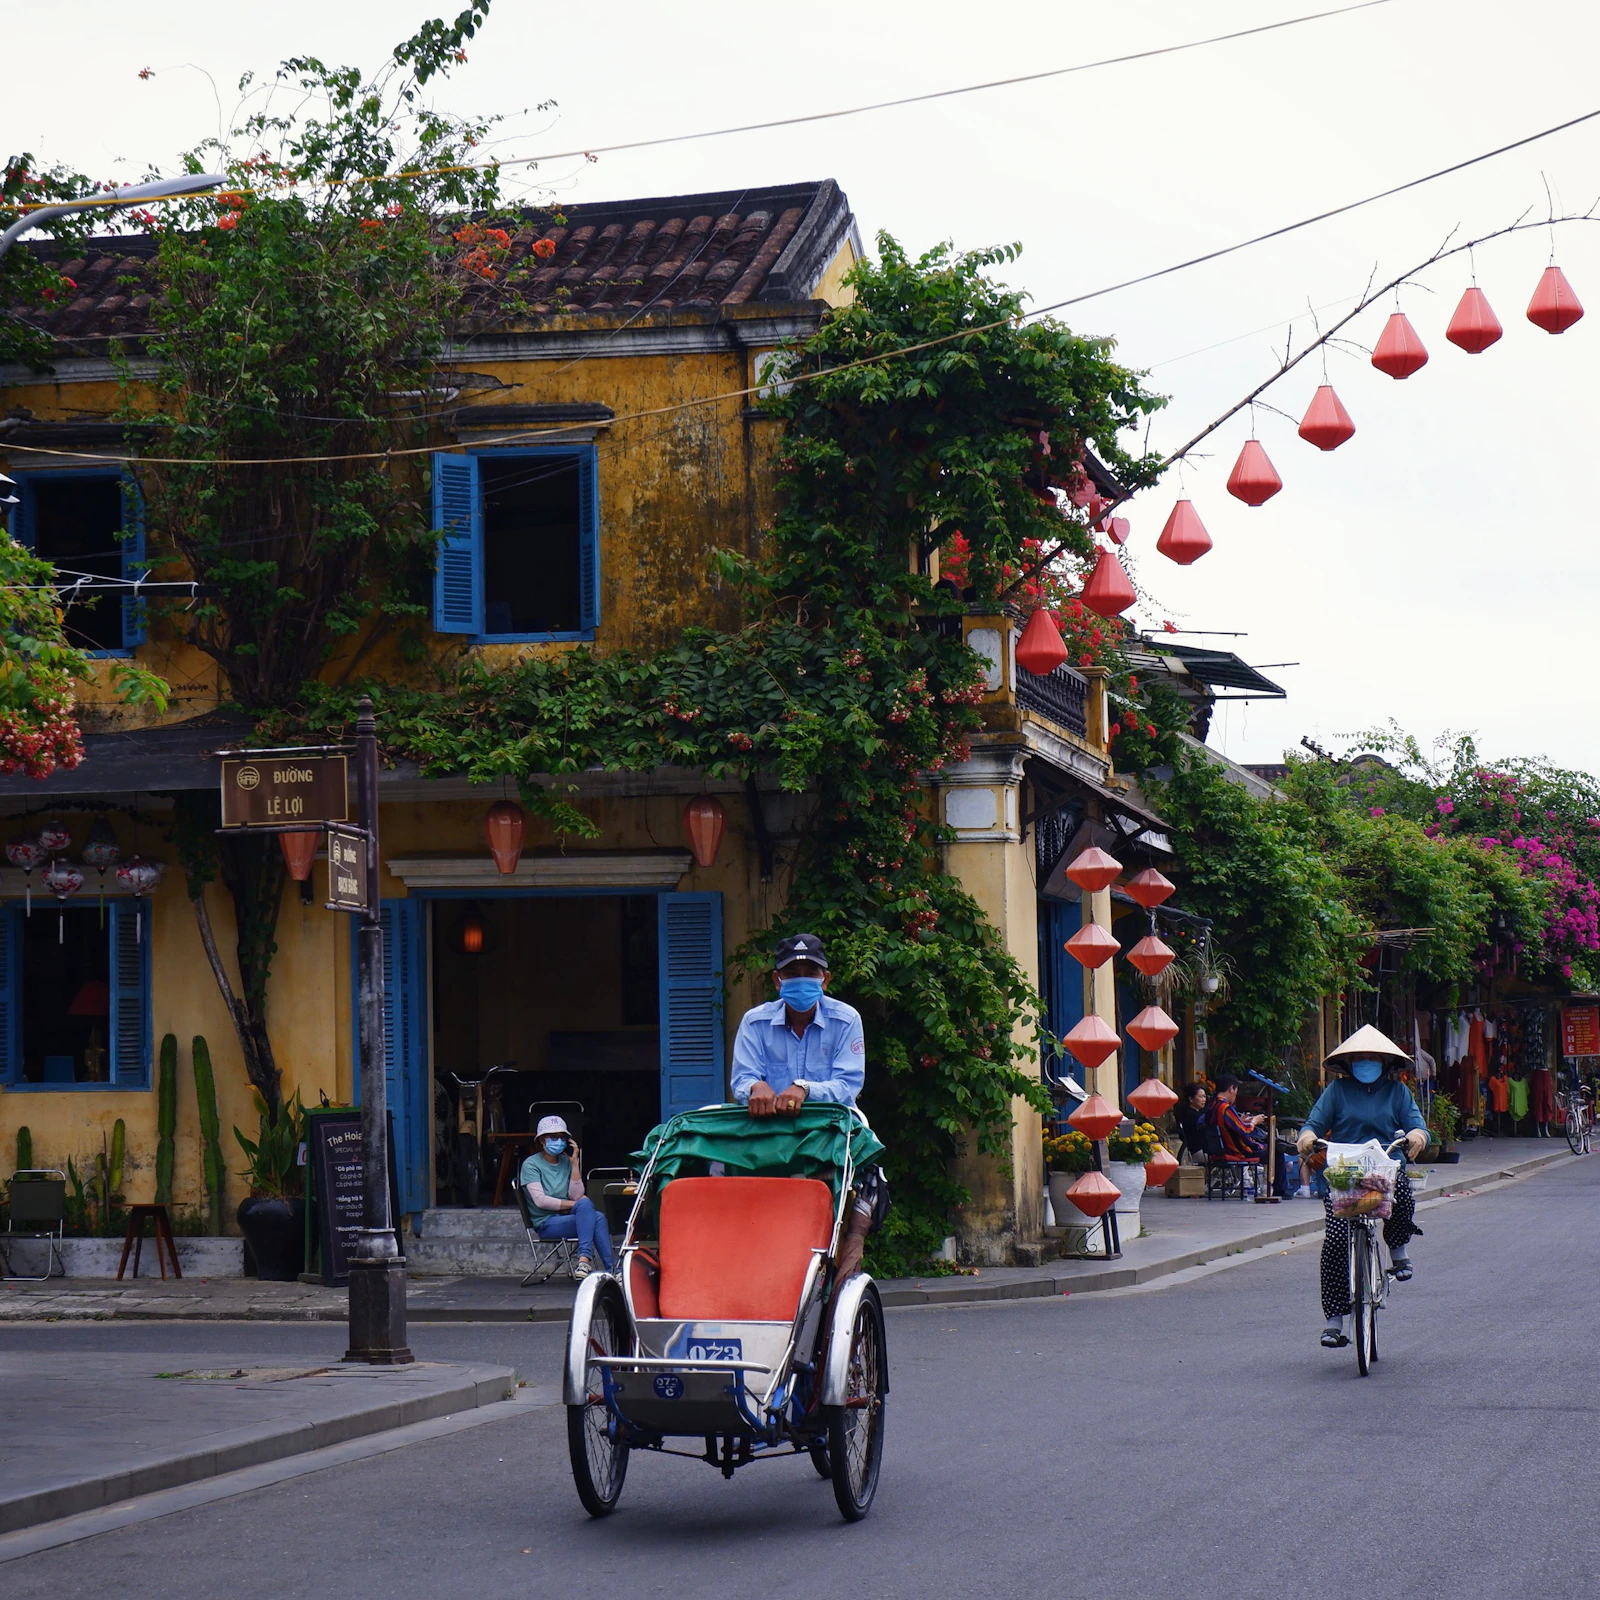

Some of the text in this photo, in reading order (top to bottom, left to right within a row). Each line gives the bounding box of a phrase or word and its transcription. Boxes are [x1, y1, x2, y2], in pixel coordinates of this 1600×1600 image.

[273, 765, 313, 784] ĐƯỜNG
[267, 795, 303, 817] LÊ LỢI
[327, 1131, 362, 1147] The Hoia
[689, 1342, 741, 1361] 073
